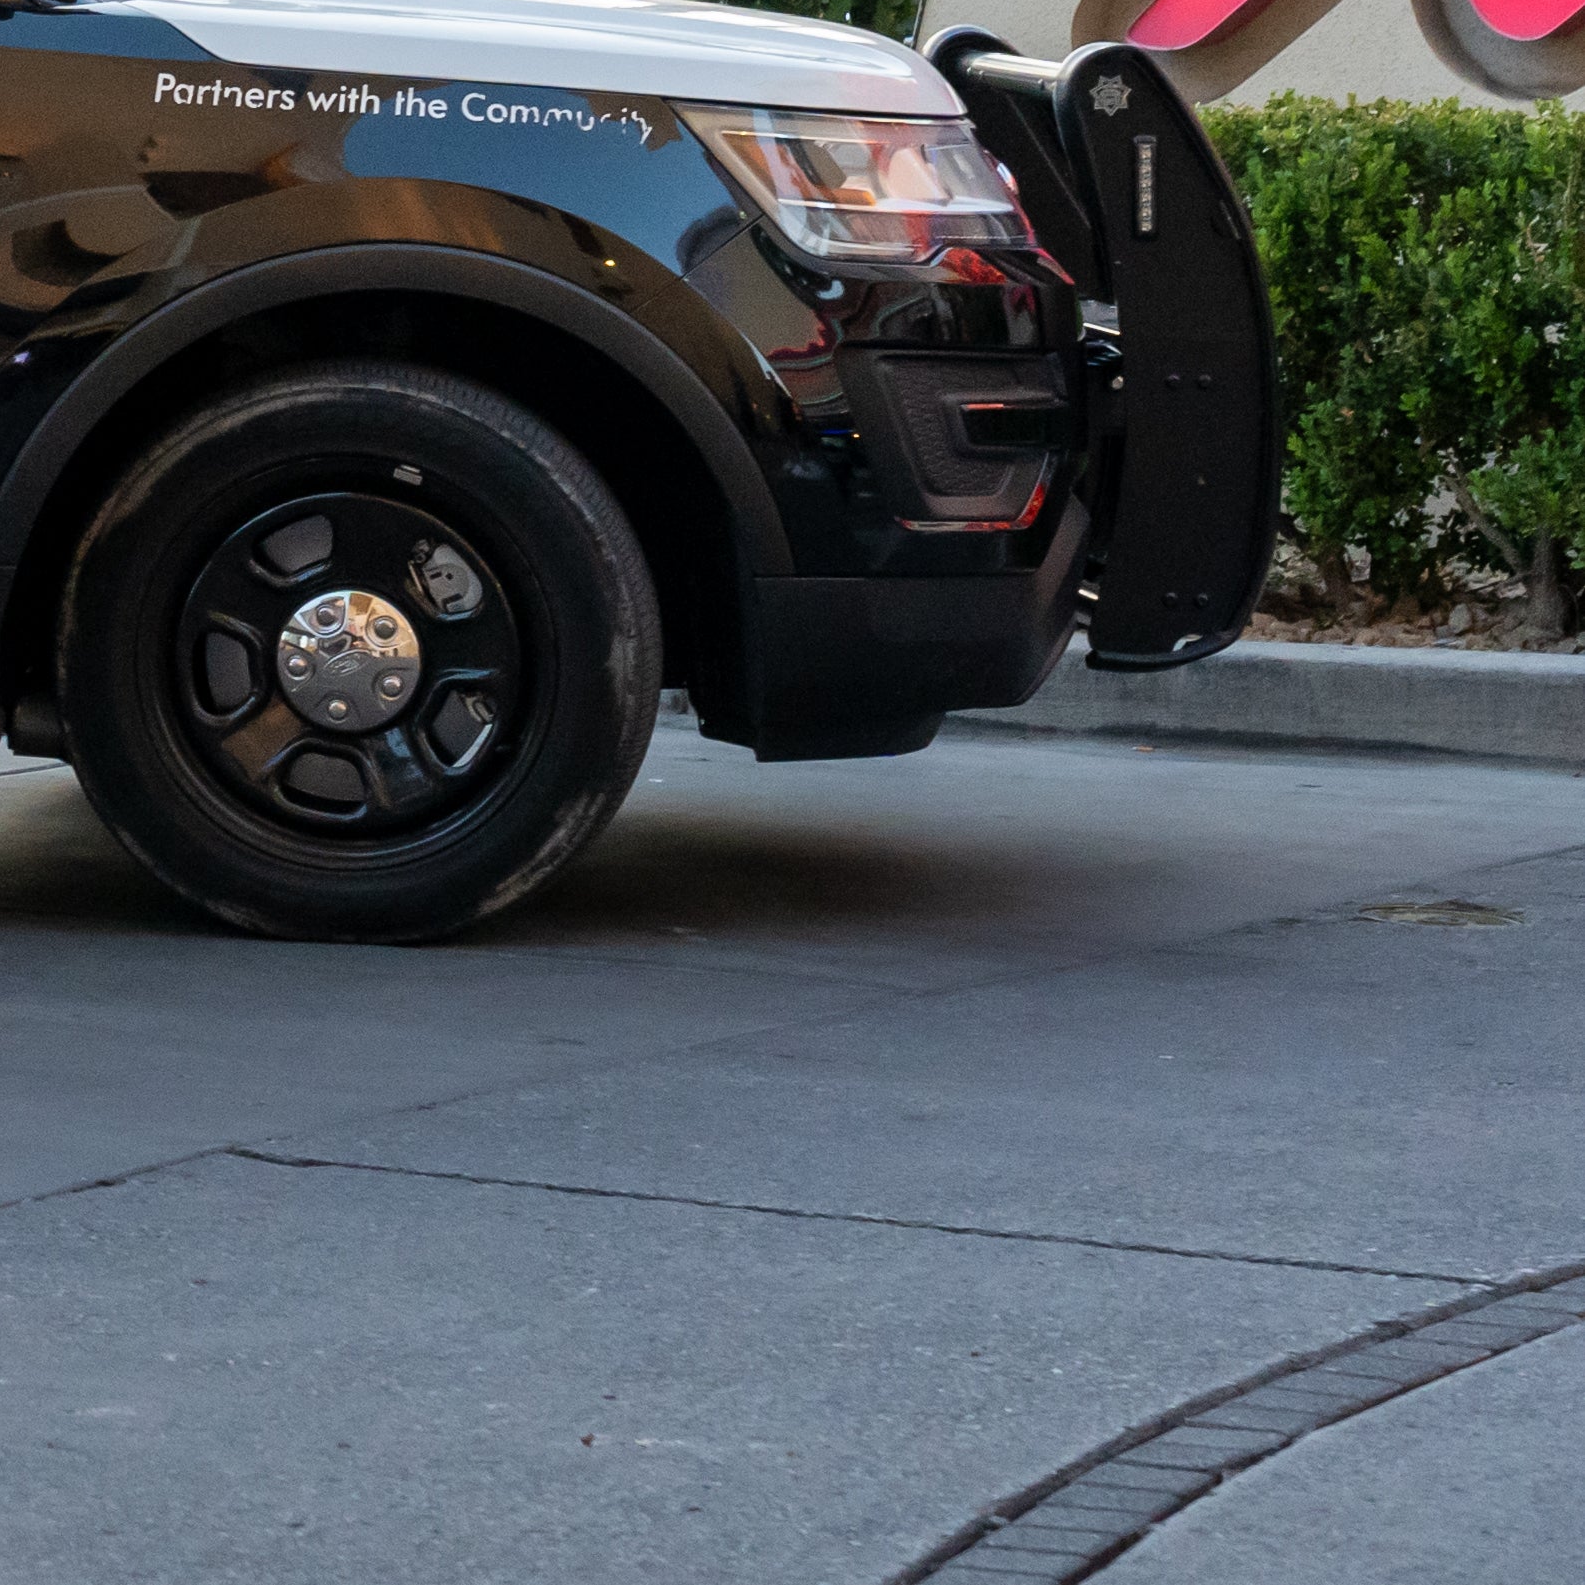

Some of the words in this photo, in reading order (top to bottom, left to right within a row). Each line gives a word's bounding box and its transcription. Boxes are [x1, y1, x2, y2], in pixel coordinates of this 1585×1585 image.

[154, 72, 296, 111] Partners
[307, 84, 381, 114] with
[394, 87, 449, 119] the
